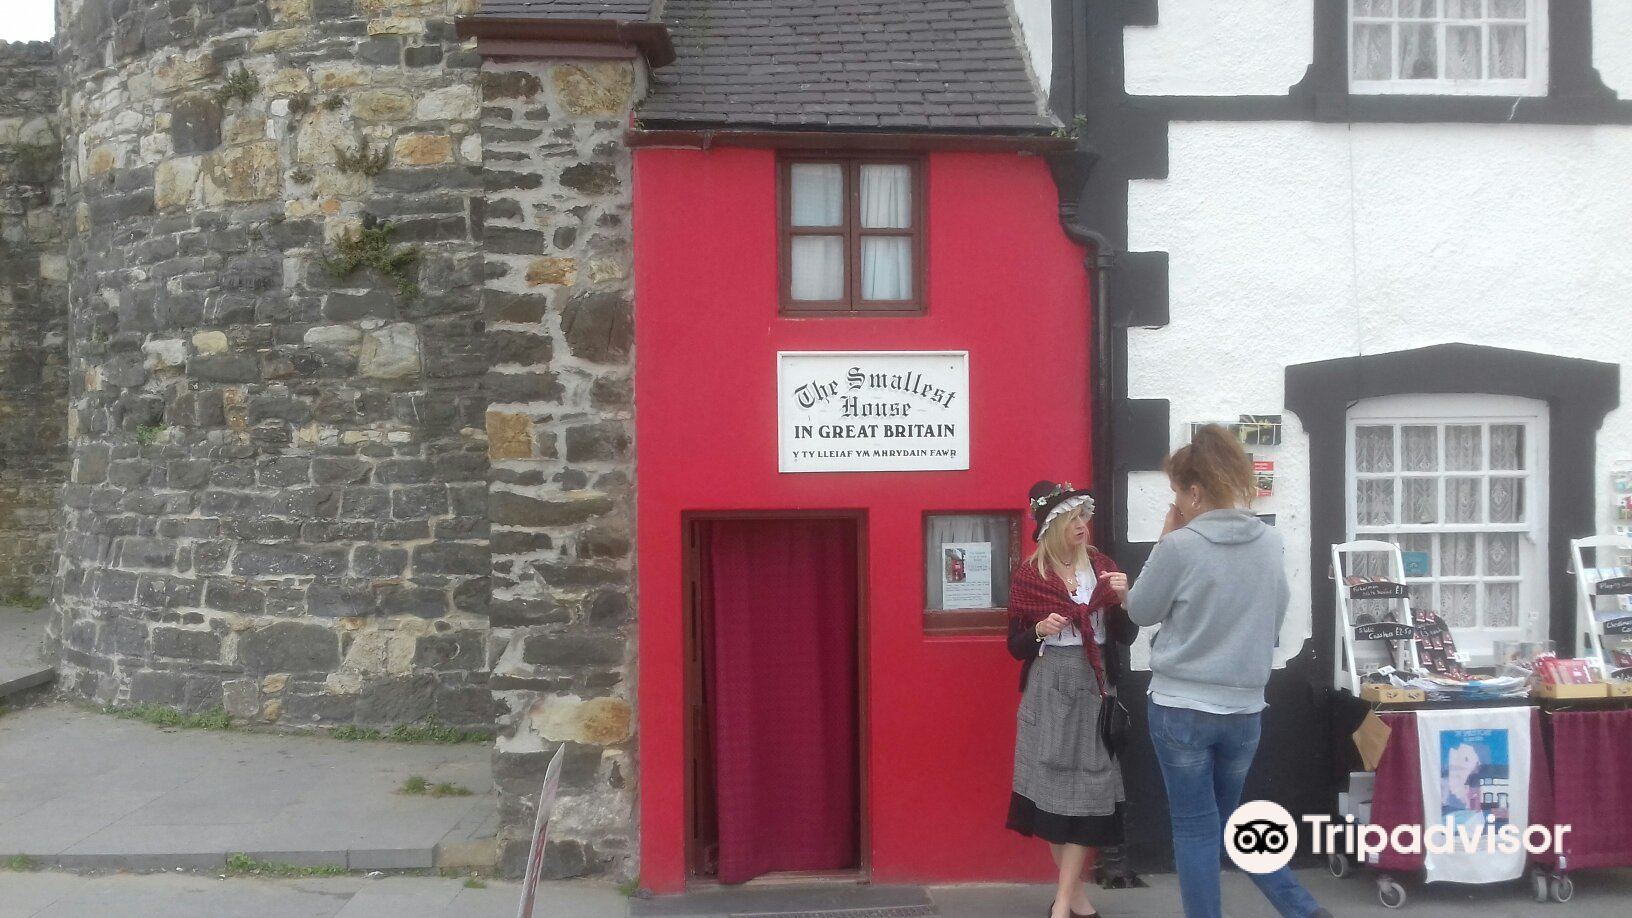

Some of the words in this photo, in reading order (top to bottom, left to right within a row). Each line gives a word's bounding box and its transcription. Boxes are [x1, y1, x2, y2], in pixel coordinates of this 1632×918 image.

[794, 380, 839, 408] The
[847, 367, 956, 408] Smallest
[840, 395, 912, 417] House
[794, 425, 813, 439] IN
[818, 424, 878, 439] GREAT
[884, 424, 956, 438] BRITAIN
[801, 450, 815, 458] TY
[817, 450, 853, 458] LLEIAF
[873, 449, 927, 457] MHRYDAIN
[930, 449, 957, 457] FAWR
